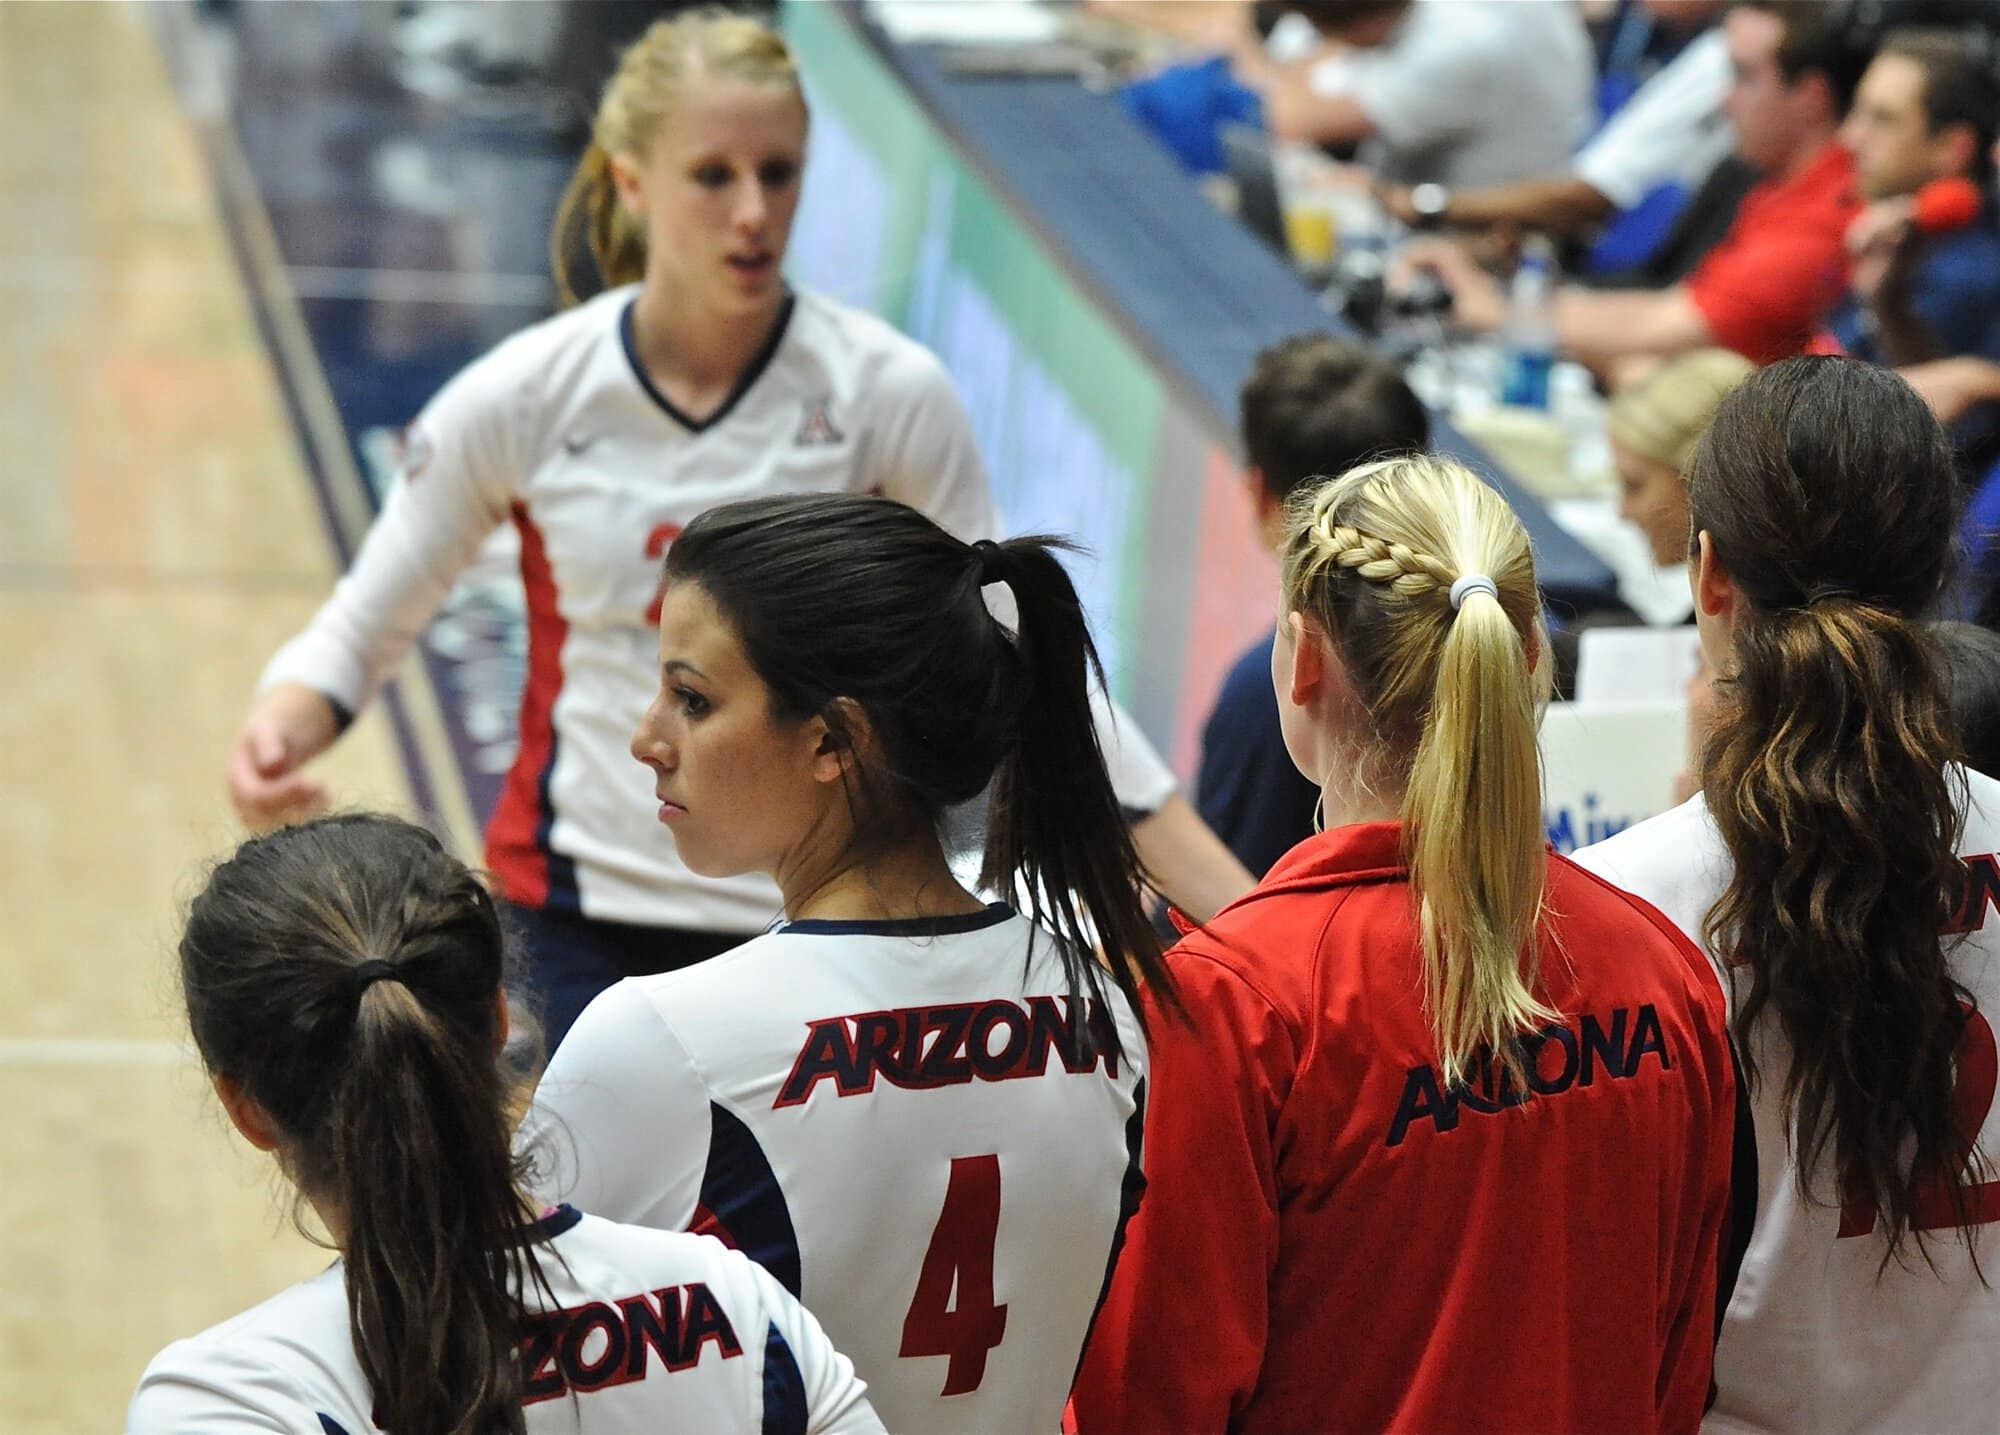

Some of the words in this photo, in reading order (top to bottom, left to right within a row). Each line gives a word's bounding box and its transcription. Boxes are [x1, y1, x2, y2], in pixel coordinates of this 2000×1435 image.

[773, 995, 1119, 1110] ARIZONA
[898, 1153, 1008, 1396] 4
[518, 1282, 744, 1407] ZONA
